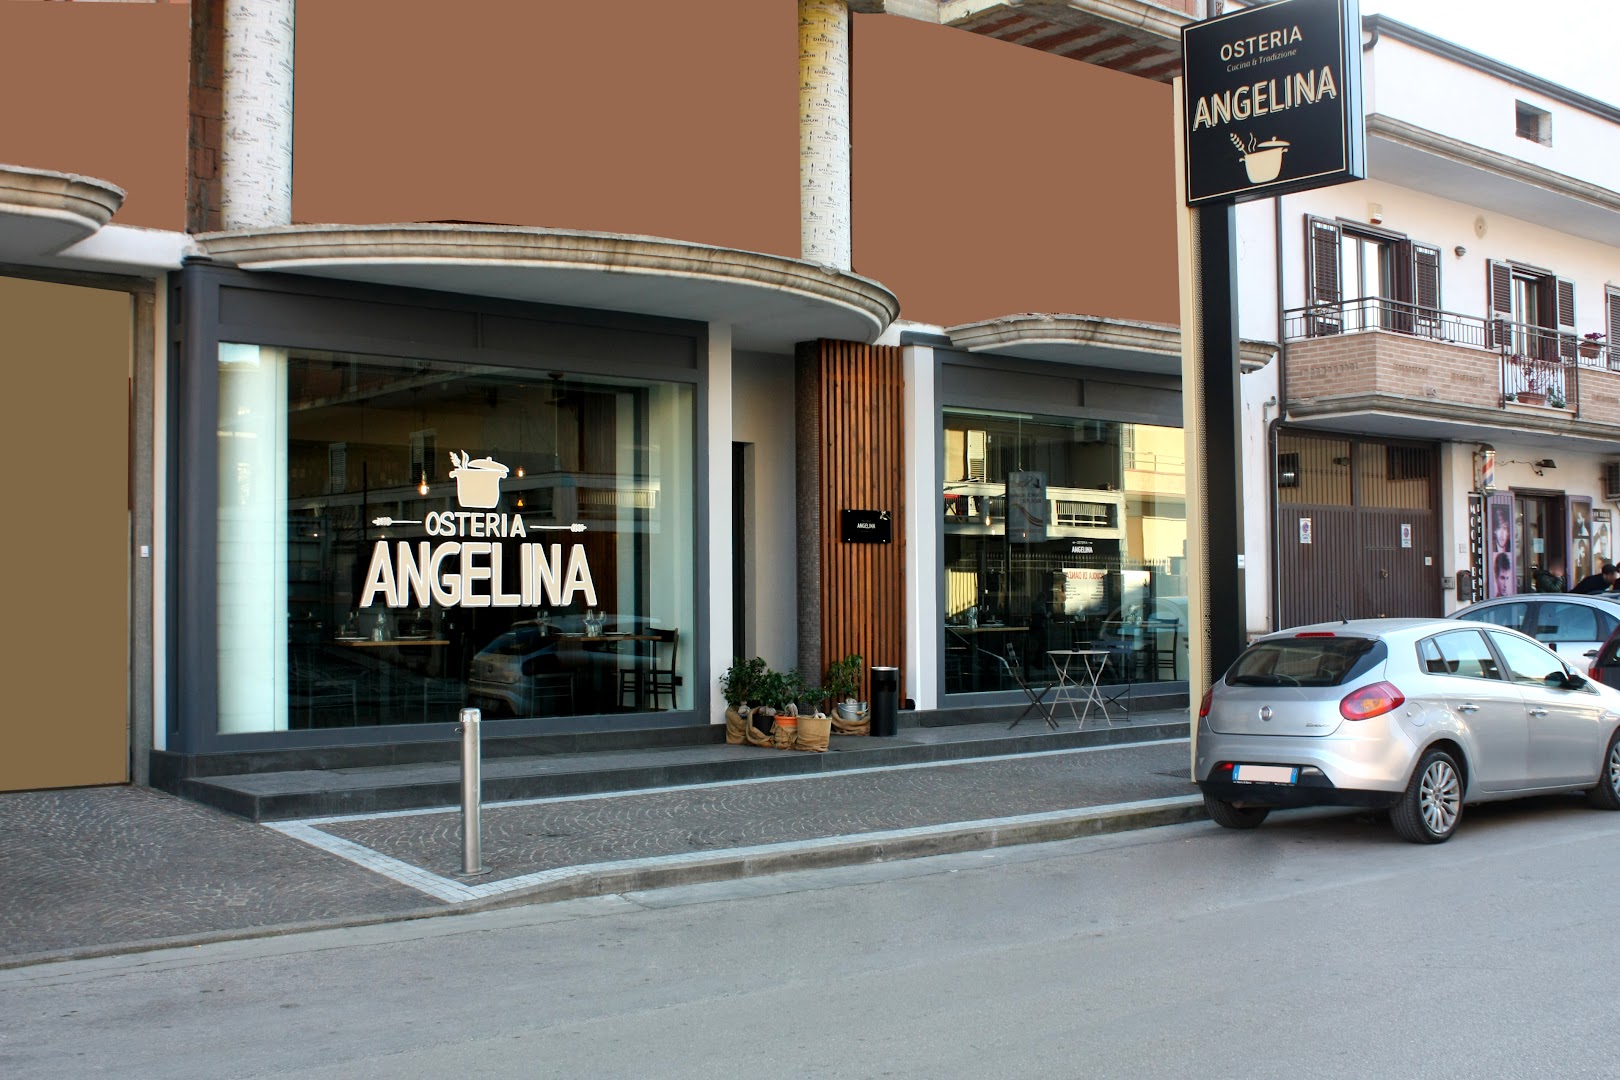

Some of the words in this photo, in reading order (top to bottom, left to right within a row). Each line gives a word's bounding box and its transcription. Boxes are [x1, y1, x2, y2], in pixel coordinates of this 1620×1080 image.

[1221, 25, 1303, 61] OSTERIA
[1227, 61, 1250, 72] Cucina
[1252, 57, 1257, 66] &
[1259, 49, 1297, 64] Tradizione
[1193, 65, 1337, 131] ANGELINA
[425, 511, 527, 538] OSTERIA
[359, 540, 598, 609] ANGELINA
